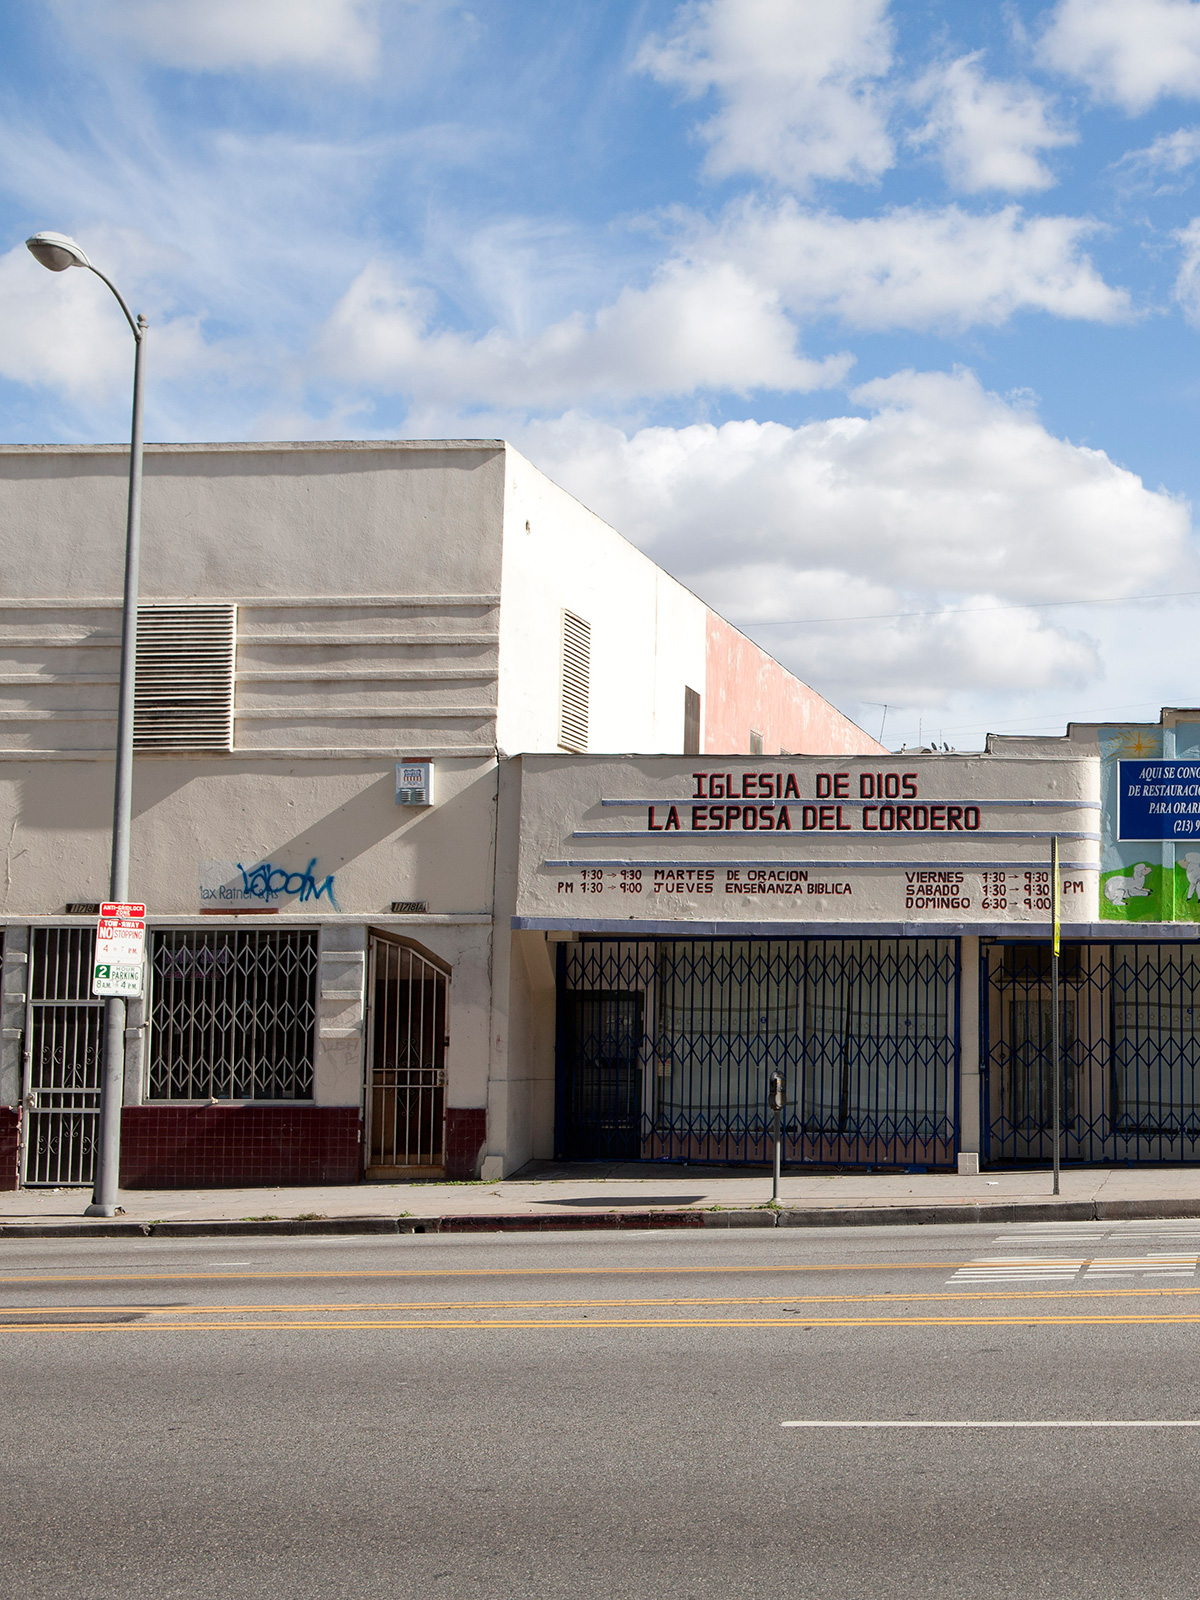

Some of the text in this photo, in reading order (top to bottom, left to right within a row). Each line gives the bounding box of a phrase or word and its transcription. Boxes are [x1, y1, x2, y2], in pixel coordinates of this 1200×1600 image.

[1139, 767, 1163, 781] AQUI
[1163, 767, 1176, 778] SE
[692, 773, 918, 799] IGLESIA DE DIOS
[1128, 785, 1141, 796] DE
[1149, 802, 1172, 814] PARA
[648, 805, 981, 831] LA ESPOSA DEL CORDERO
[1173, 820, 1193, 834] (213)
[620, 869, 642, 880] 9:30
[654, 869, 715, 880] MARTES
[727, 870, 740, 880] DE
[747, 870, 808, 881] ORACION
[905, 871, 964, 883] VIERNES
[1024, 871, 1049, 884] 9:30
[557, 882, 574, 893] PM
[619, 882, 642, 893] 9:00
[653, 882, 713, 893] JUEVES
[725, 881, 803, 894] ENSEÑANZA
[807, 883, 852, 894] BIBLICA
[906, 884, 960, 896] SABADO
[1023, 884, 1050, 896] 9:30
[1063, 880, 1084, 894] PM
[905, 897, 1051, 910] DOMINGO 6:30 9:00
[99, 927, 143, 939] NO STOPPING
[103, 944, 109, 952] 4
[98, 966, 107, 977] 2
[112, 971, 139, 980] PARKING
[96, 980, 101, 988] 8
